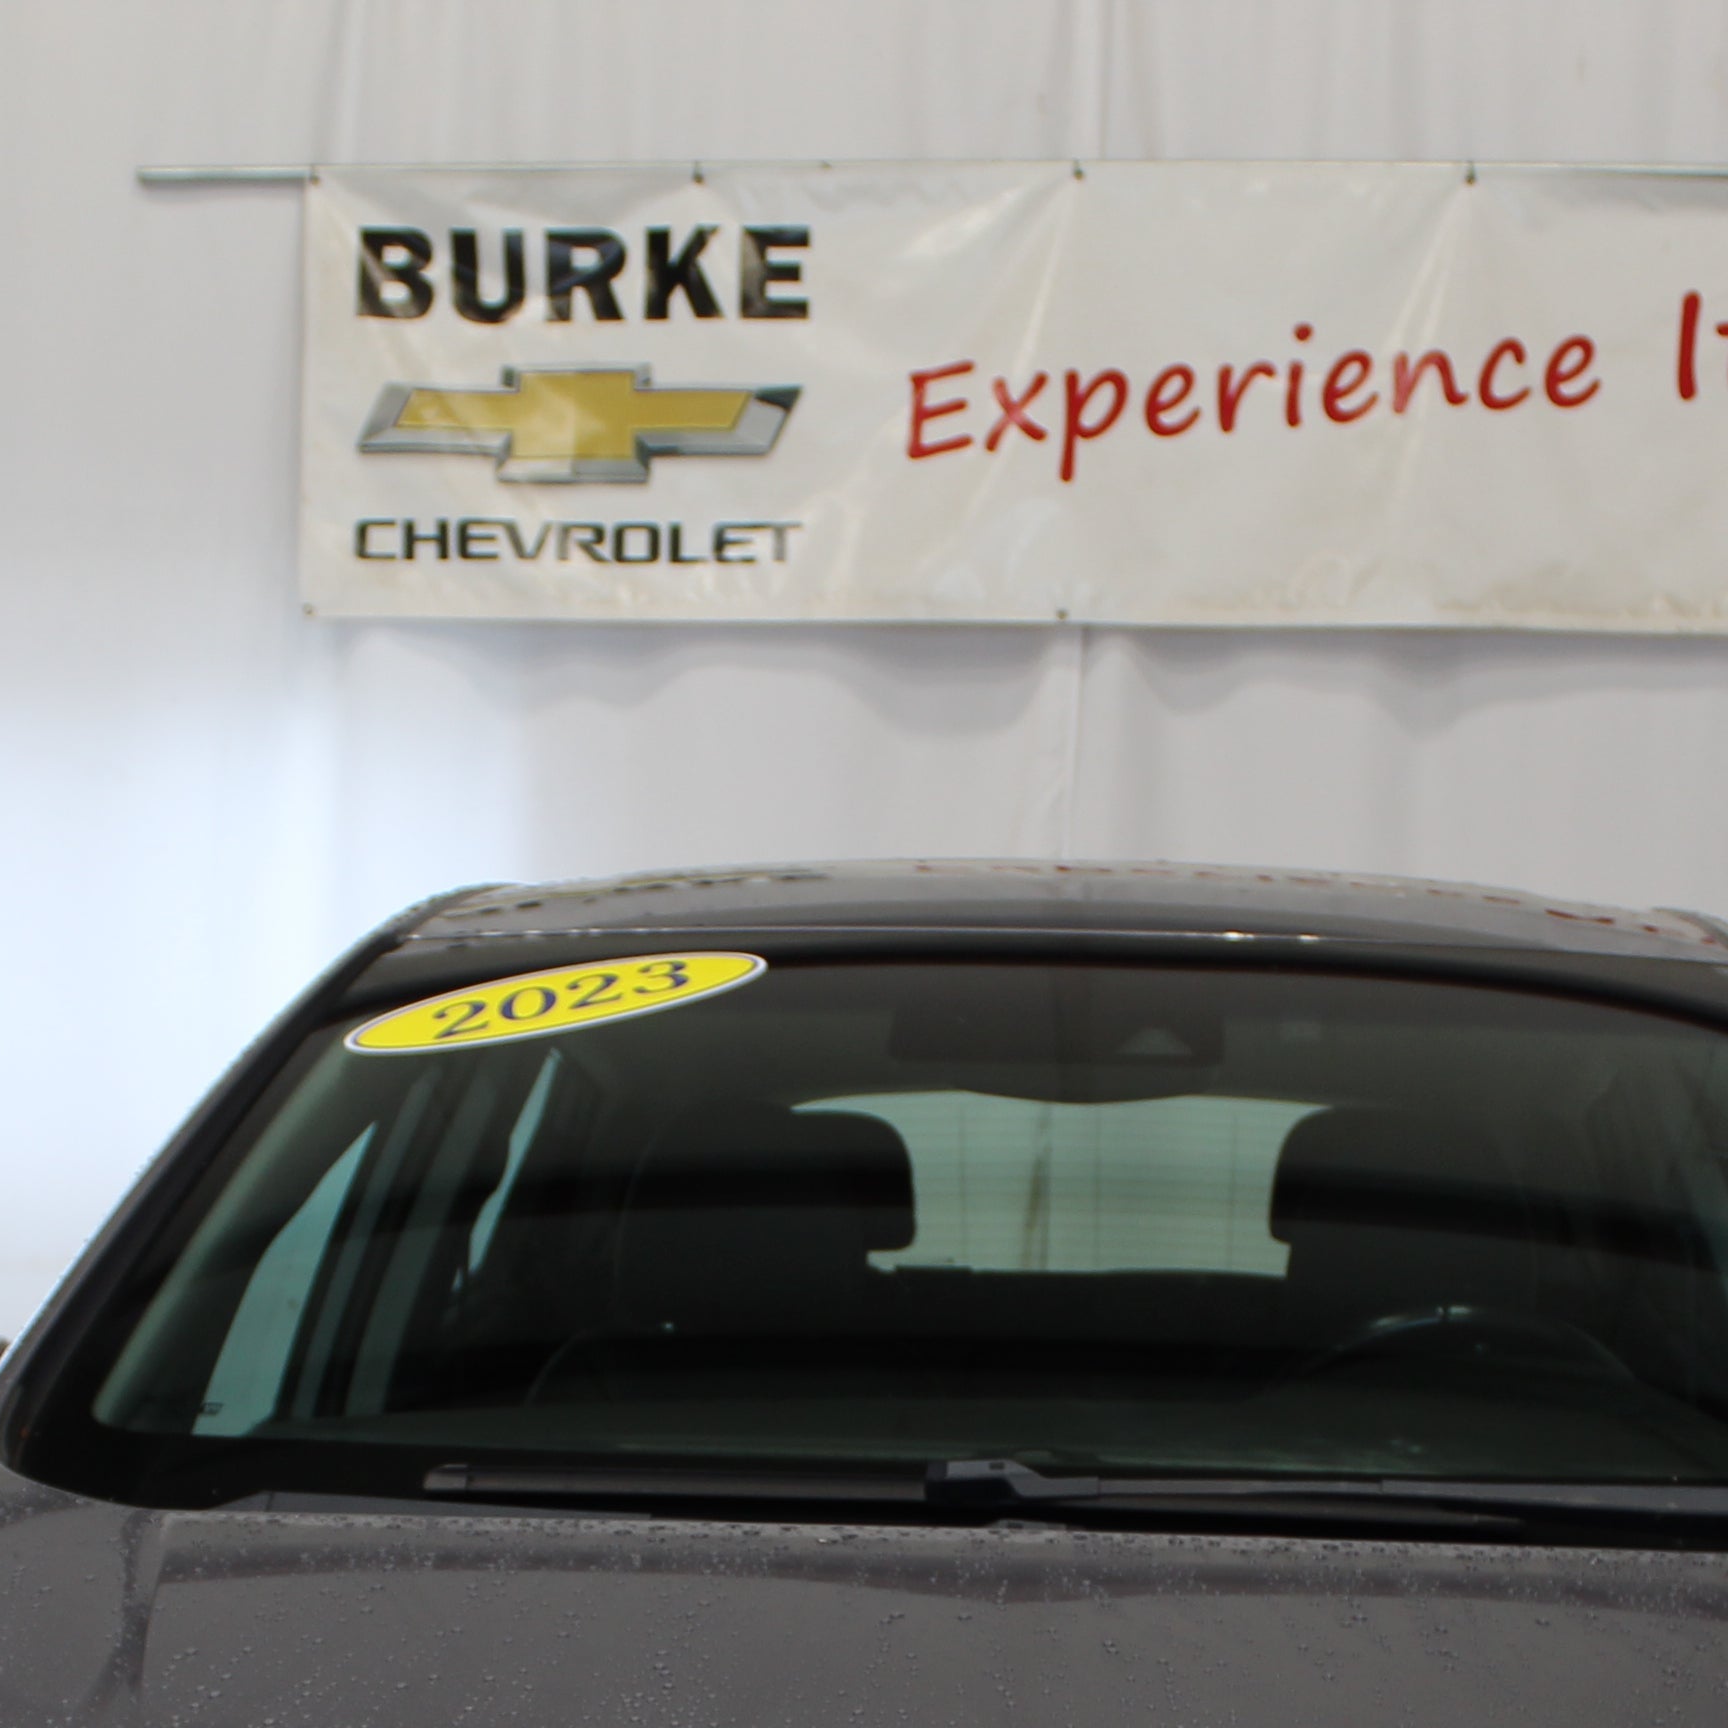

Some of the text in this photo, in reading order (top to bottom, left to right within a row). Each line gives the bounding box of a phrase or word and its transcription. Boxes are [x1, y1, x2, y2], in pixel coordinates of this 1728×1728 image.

[356, 226, 810, 323] BURKE
[905, 324, 1600, 481] Experience
[355, 518, 802, 564] CHEVROLET
[433, 961, 689, 1039] 2023
